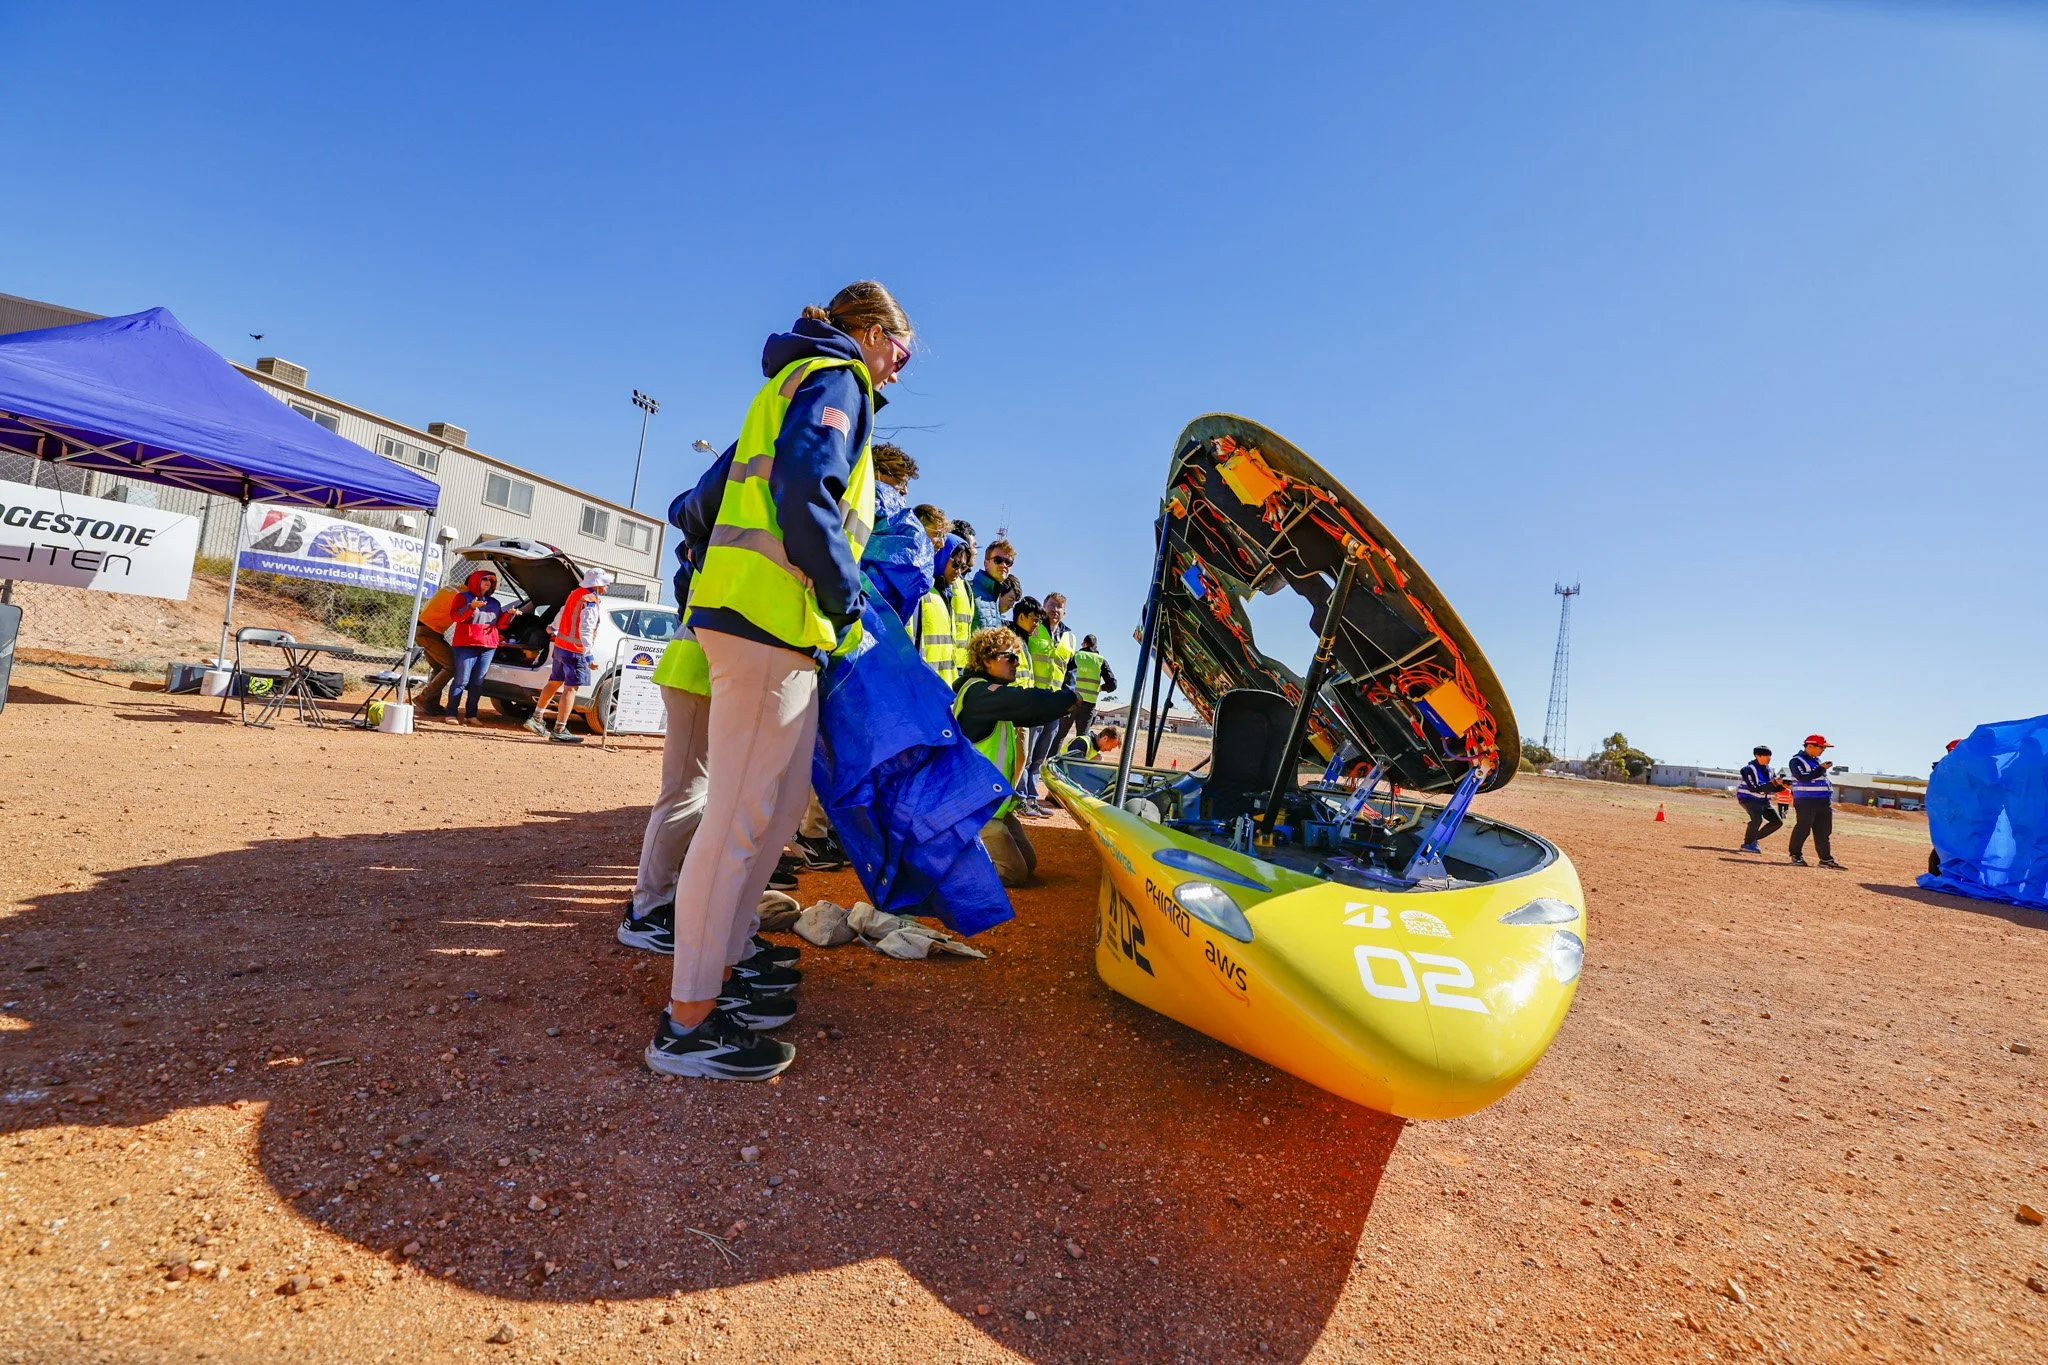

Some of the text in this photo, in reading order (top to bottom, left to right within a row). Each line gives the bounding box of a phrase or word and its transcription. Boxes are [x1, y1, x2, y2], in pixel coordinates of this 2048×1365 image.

[0, 503, 156, 547] GESTONE
[389, 535, 440, 559] WORD
[392, 563, 437, 583] CHALLNGE
[1205, 940, 1247, 991] aws
[1353, 944, 1491, 1014] 02
